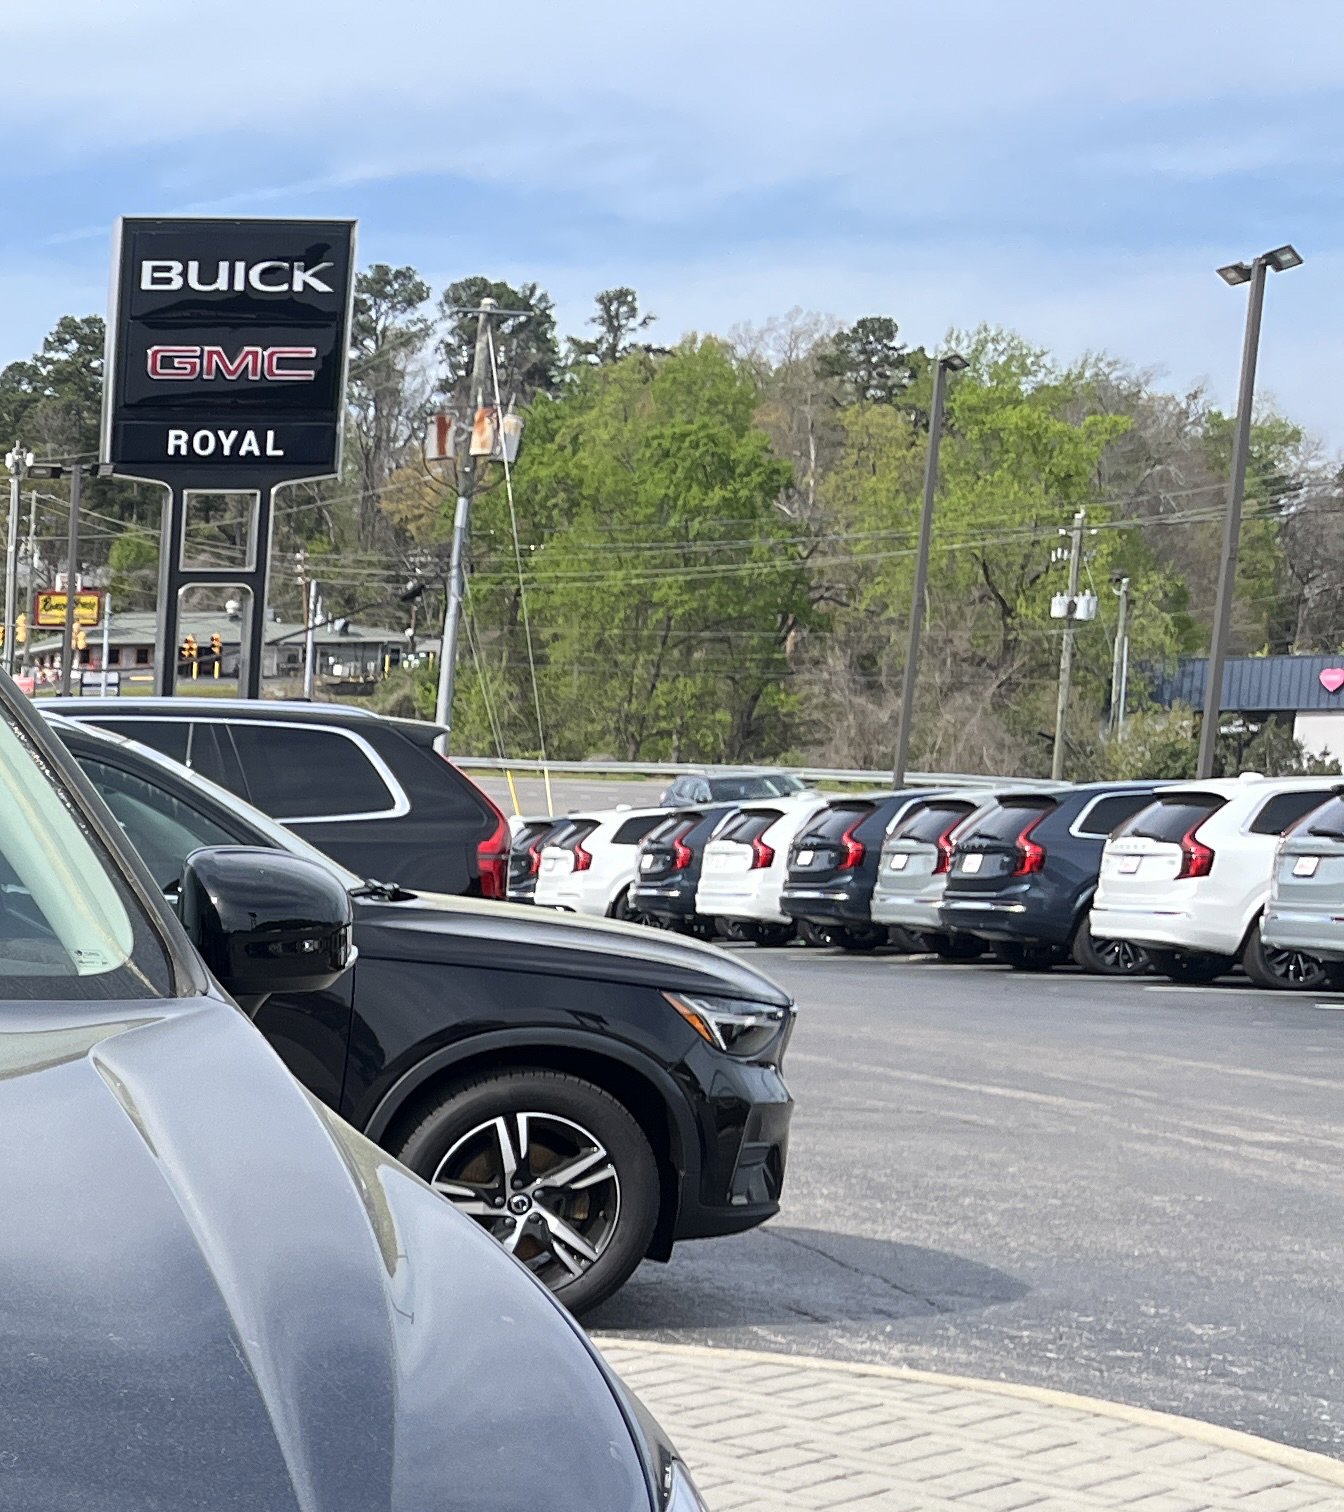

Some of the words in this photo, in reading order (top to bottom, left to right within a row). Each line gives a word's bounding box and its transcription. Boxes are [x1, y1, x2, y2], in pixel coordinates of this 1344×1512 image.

[140, 259, 335, 293] BUICK
[146, 344, 317, 381] GMC
[166, 428, 285, 457] ROYAL
